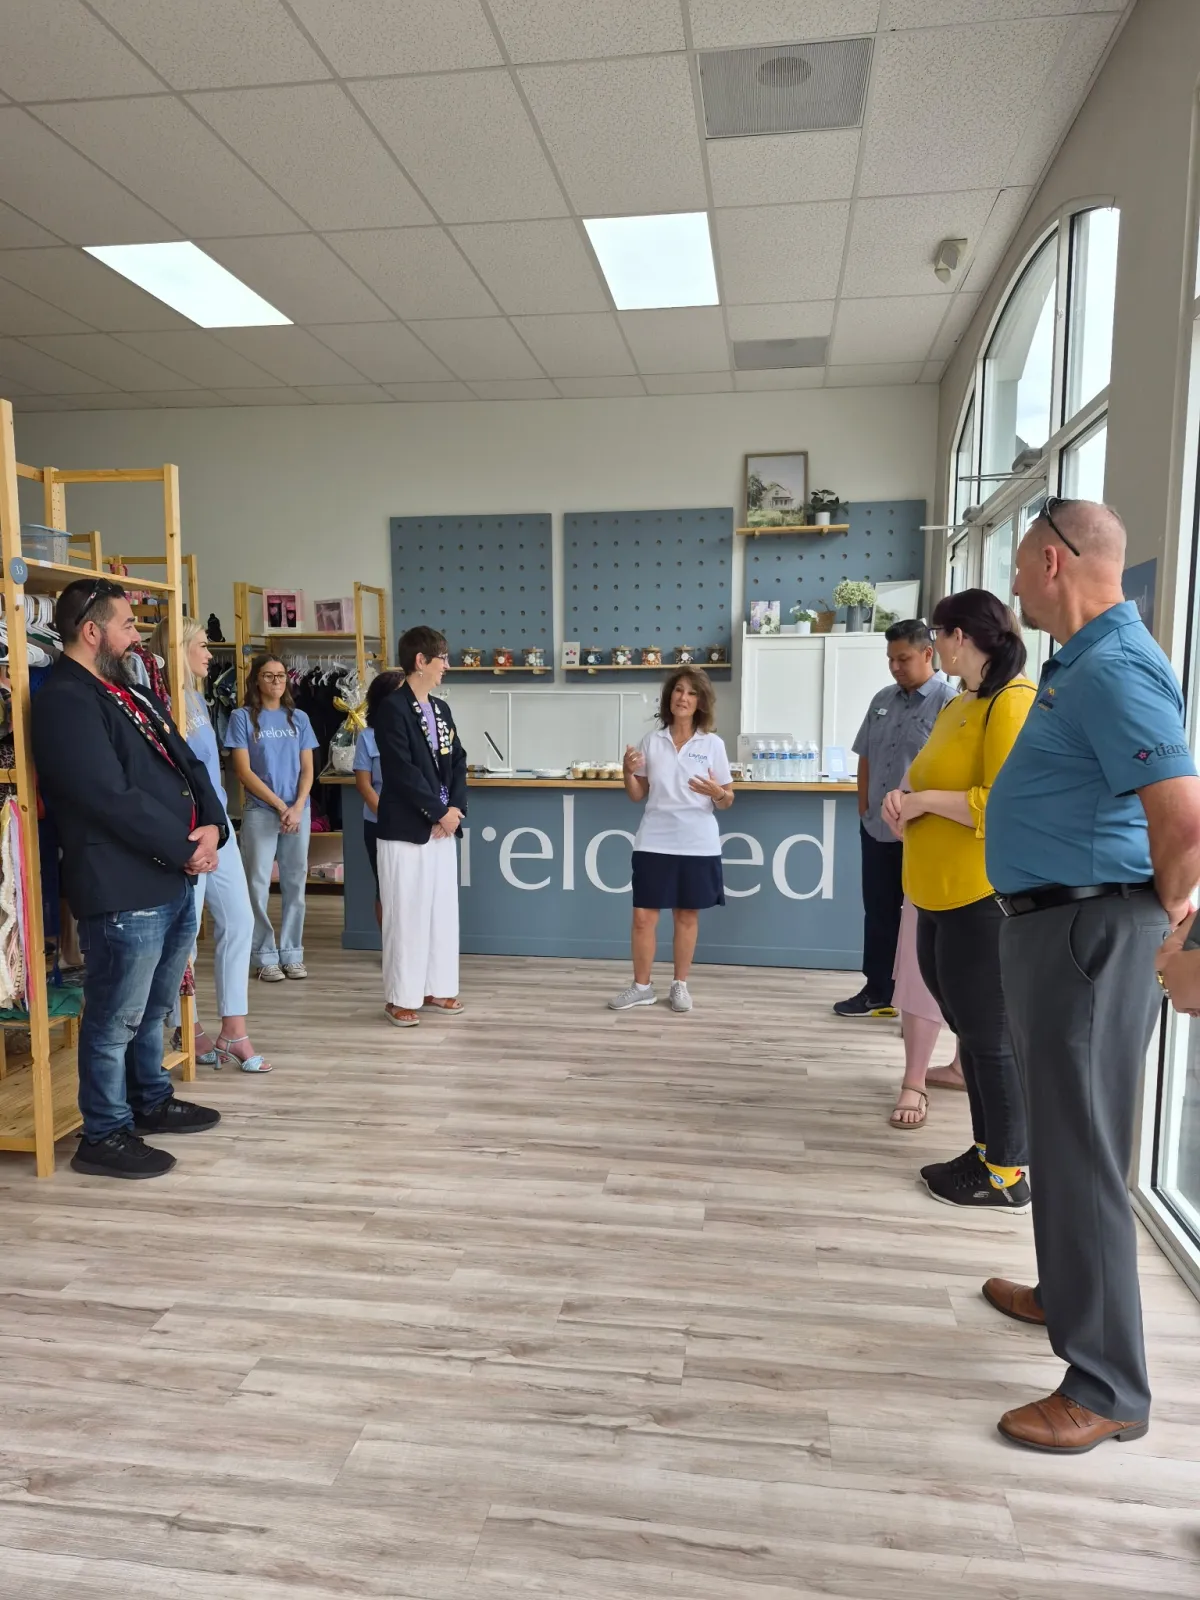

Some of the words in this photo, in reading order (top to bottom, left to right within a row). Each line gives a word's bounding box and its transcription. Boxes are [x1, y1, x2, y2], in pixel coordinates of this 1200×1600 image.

[14, 565, 24, 575] 33
[1155, 743, 1188, 756] tiare
[460, 794, 835, 900] reloed
